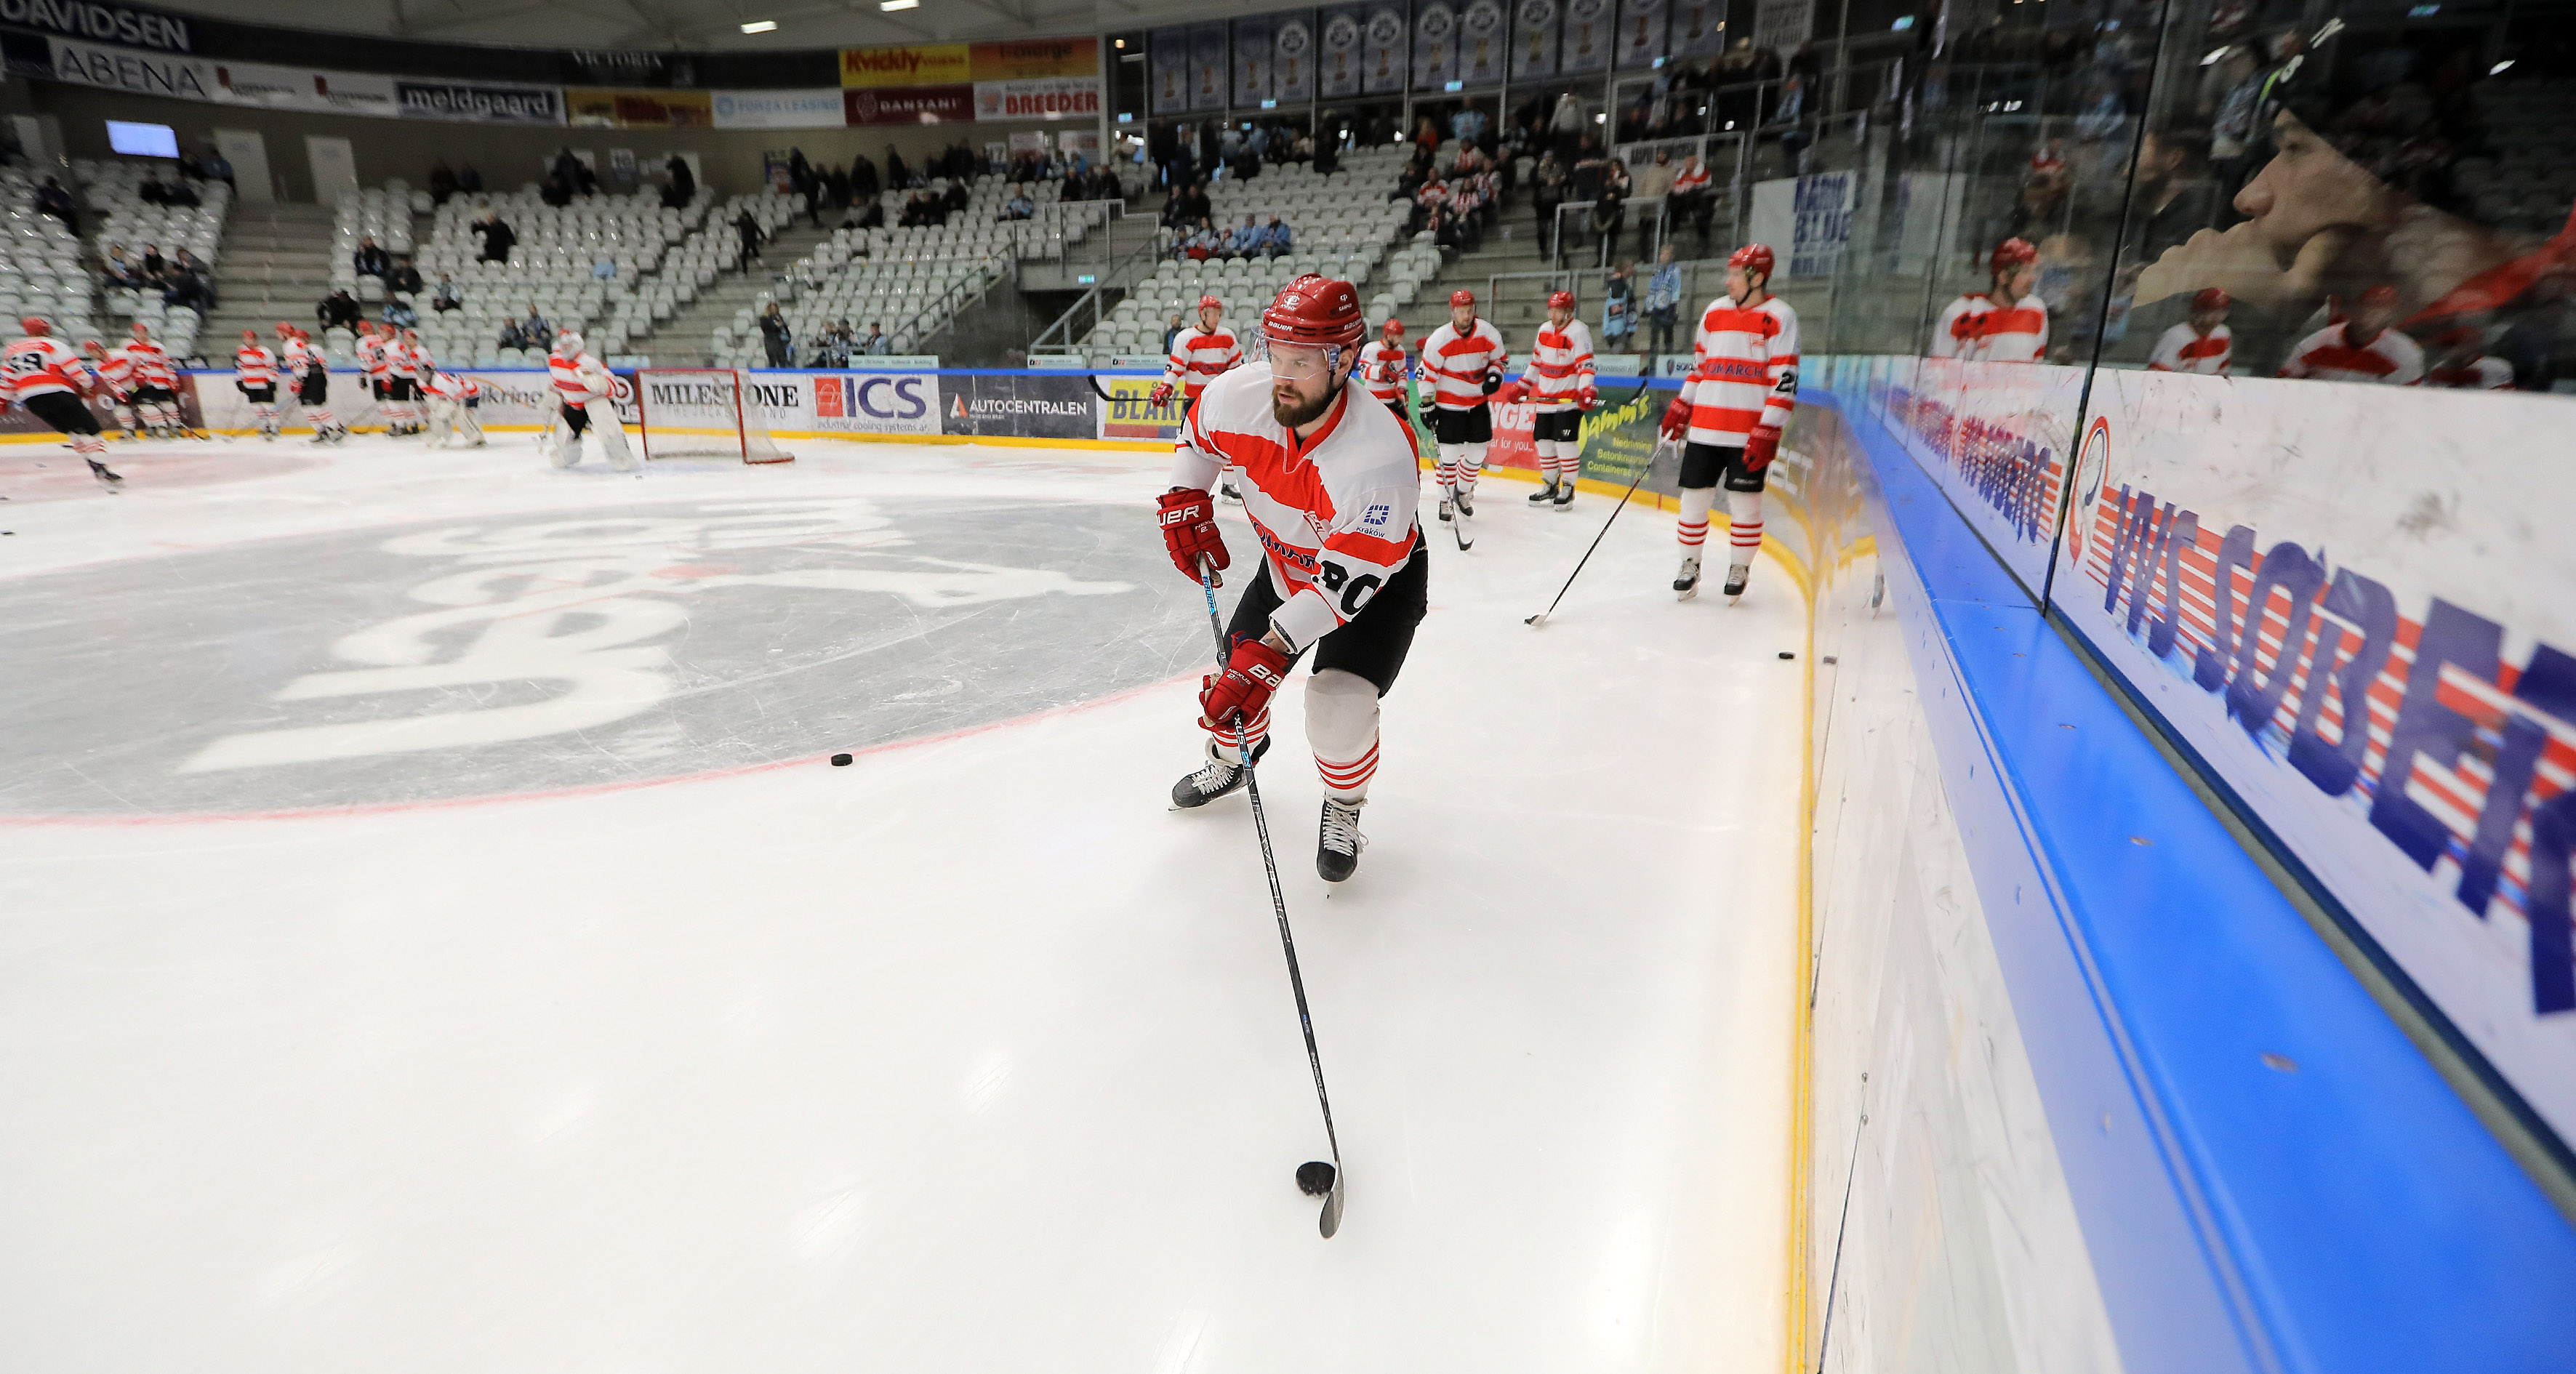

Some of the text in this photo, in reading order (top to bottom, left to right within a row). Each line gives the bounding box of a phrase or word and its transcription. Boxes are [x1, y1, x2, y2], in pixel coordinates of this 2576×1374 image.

[60, 47, 204, 96] ABENA
[846, 48, 922, 73] Kvickly
[405, 86, 551, 124] meldgaard
[880, 98, 957, 113] DANSANI
[1006, 92, 1099, 114] BREEDER
[1706, 363, 1763, 378] OMARCH
[650, 383, 798, 407] MILESTONE
[846, 377, 927, 419] ICS
[970, 399, 1088, 416] AUTOCENTRALEN
[1501, 438, 1512, 449] for
[1356, 527, 1385, 538] Kraków
[2104, 482, 2199, 659] VVS
[1228, 668, 1252, 686] NEXUS
